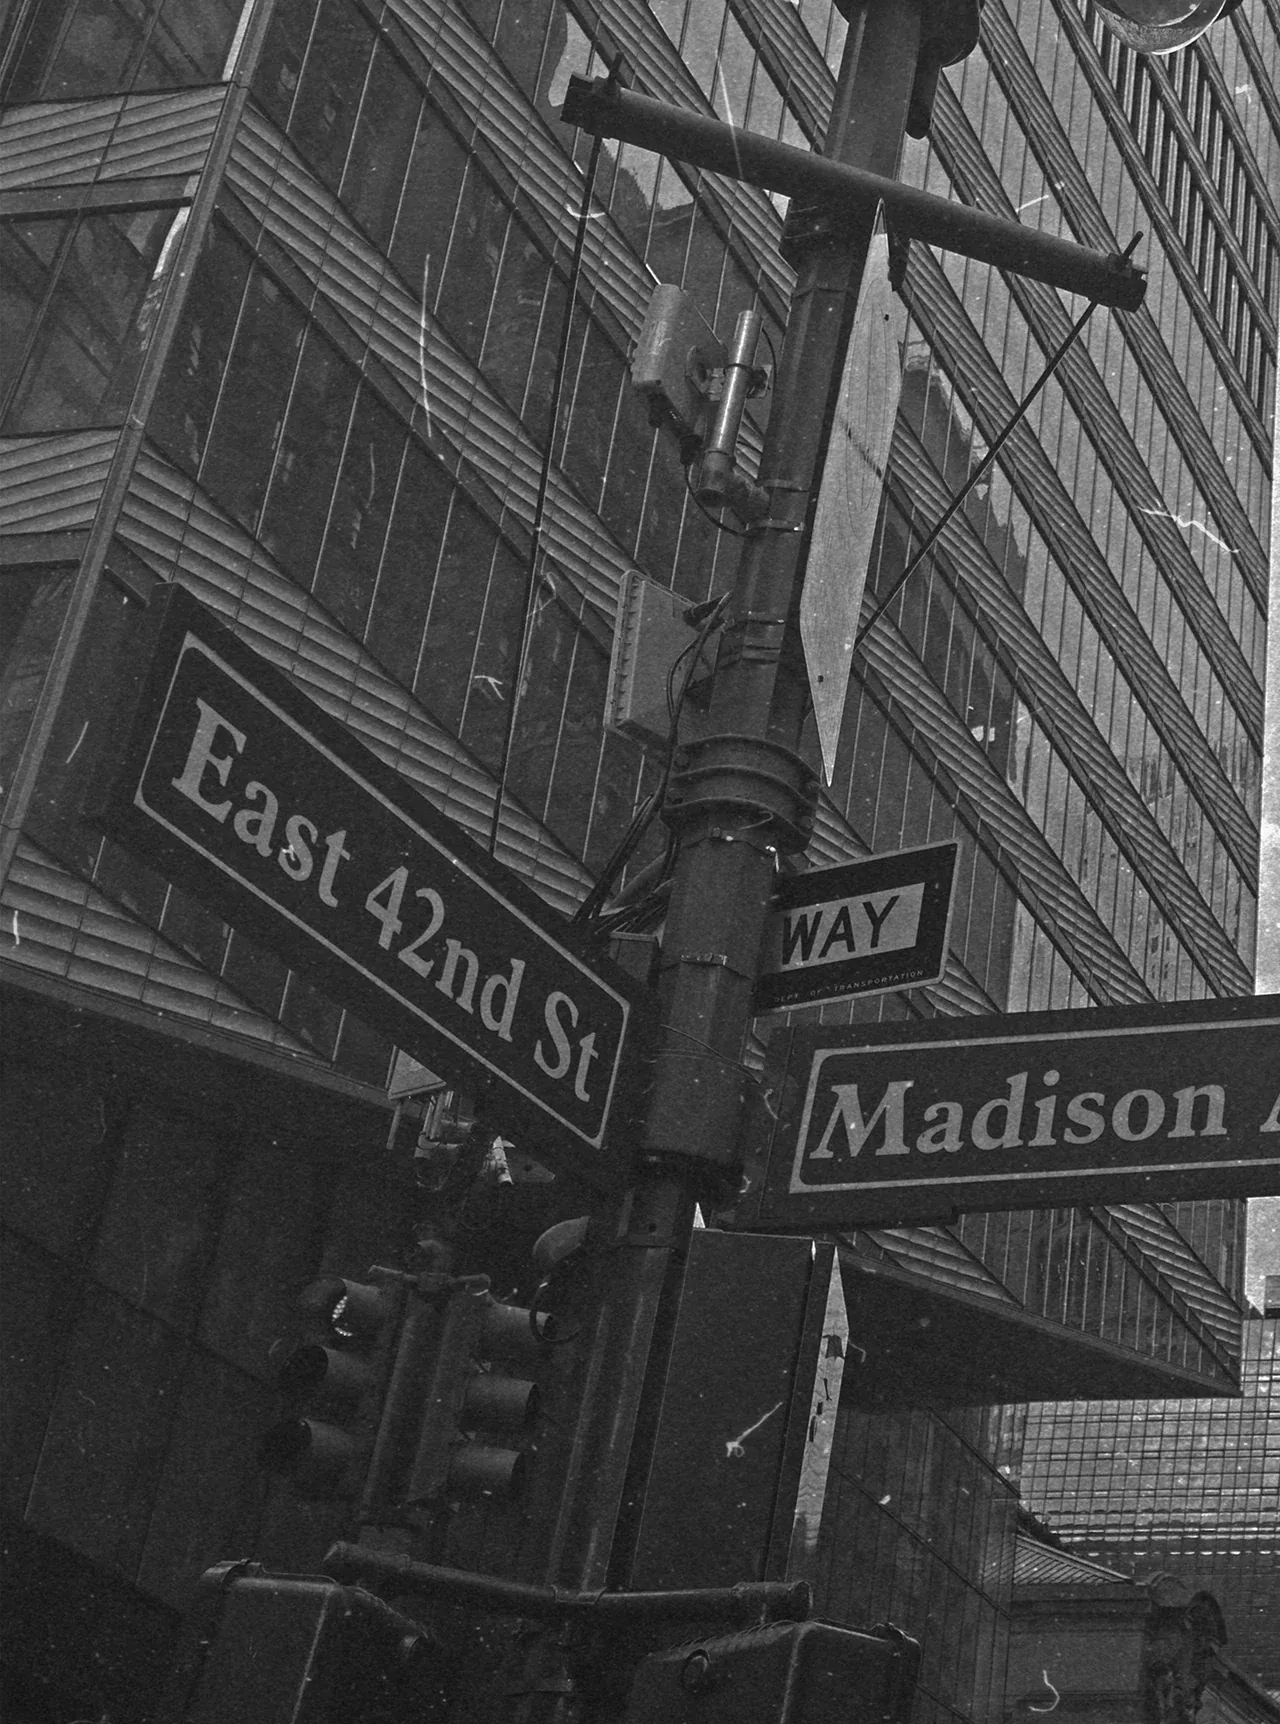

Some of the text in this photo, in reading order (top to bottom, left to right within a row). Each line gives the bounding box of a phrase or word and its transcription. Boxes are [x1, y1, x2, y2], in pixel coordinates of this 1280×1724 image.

[171, 697, 599, 1102] East 42nd St
[782, 895, 900, 966] WAY
[810, 988, 823, 997] OF
[833, 970, 924, 992] TRANSPORTATION
[809, 1069, 1228, 1161] Madison
